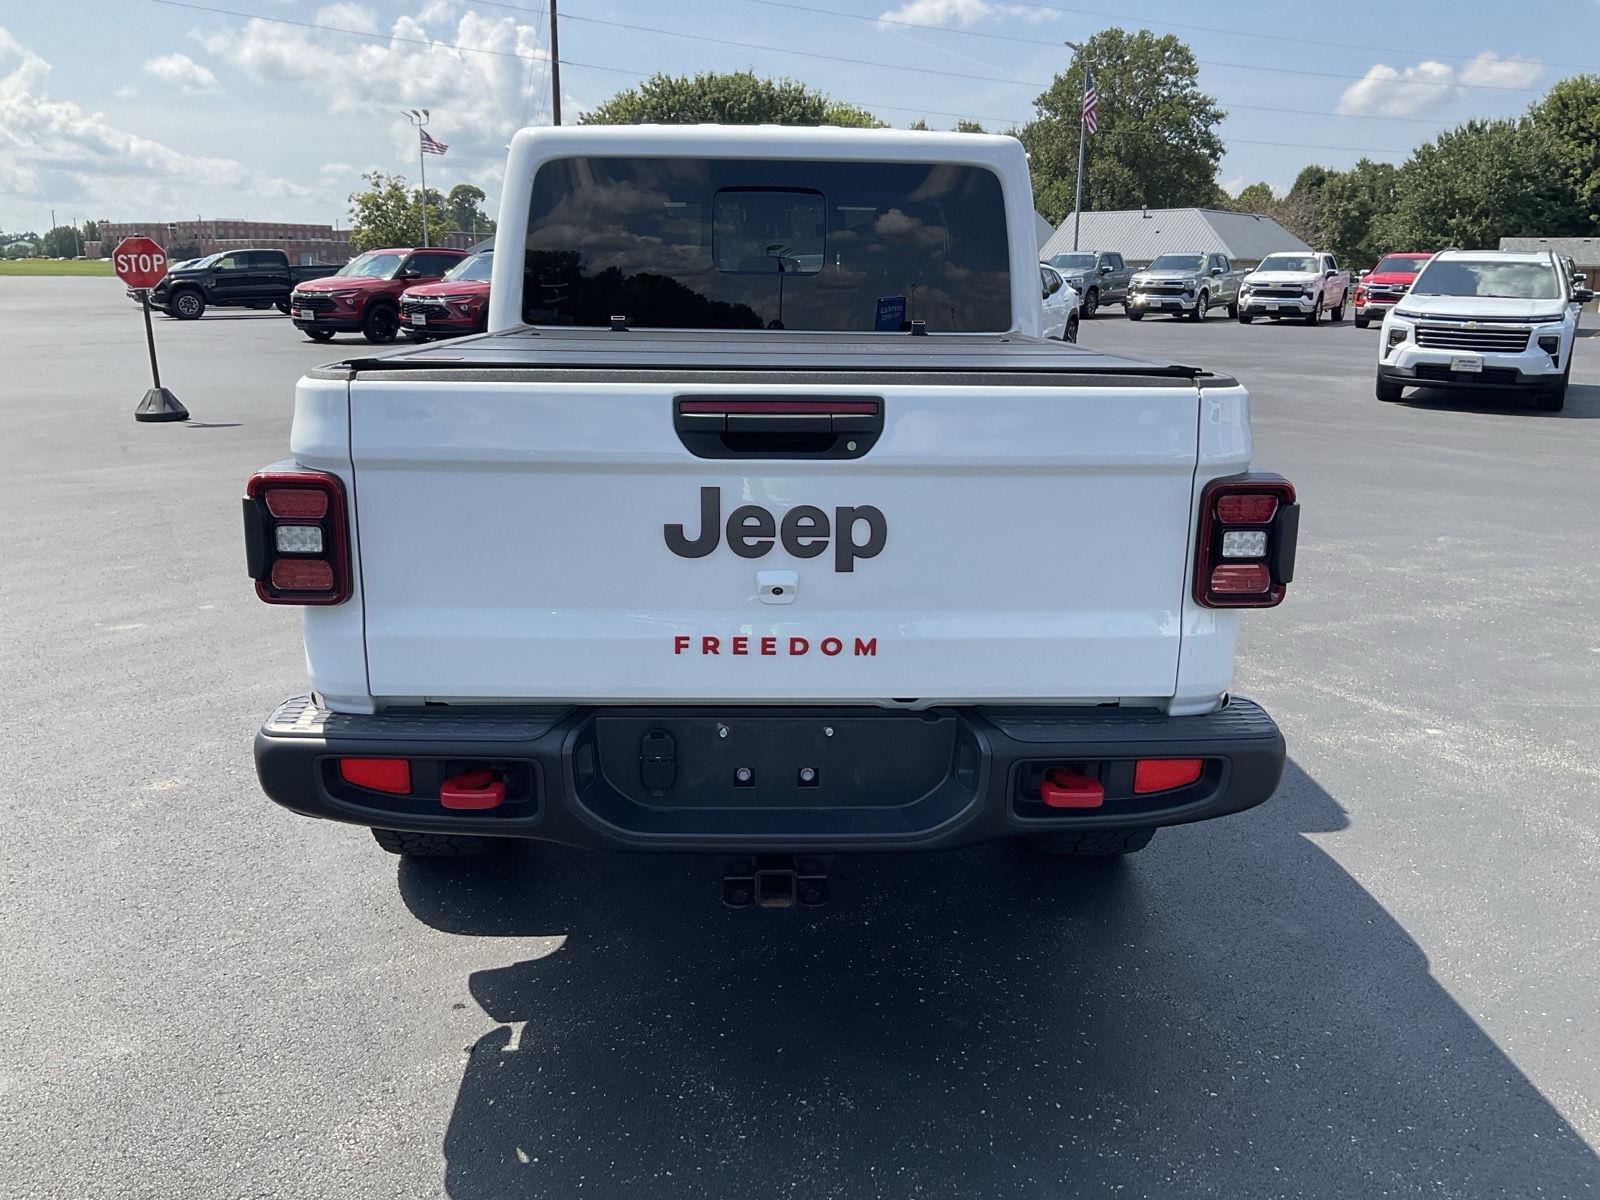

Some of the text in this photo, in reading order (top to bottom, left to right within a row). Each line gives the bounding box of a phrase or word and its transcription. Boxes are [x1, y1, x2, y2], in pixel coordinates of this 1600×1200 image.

[117, 254, 164, 273] STOP
[664, 486, 888, 572] Jeep
[674, 636, 877, 656] FREEDOM
